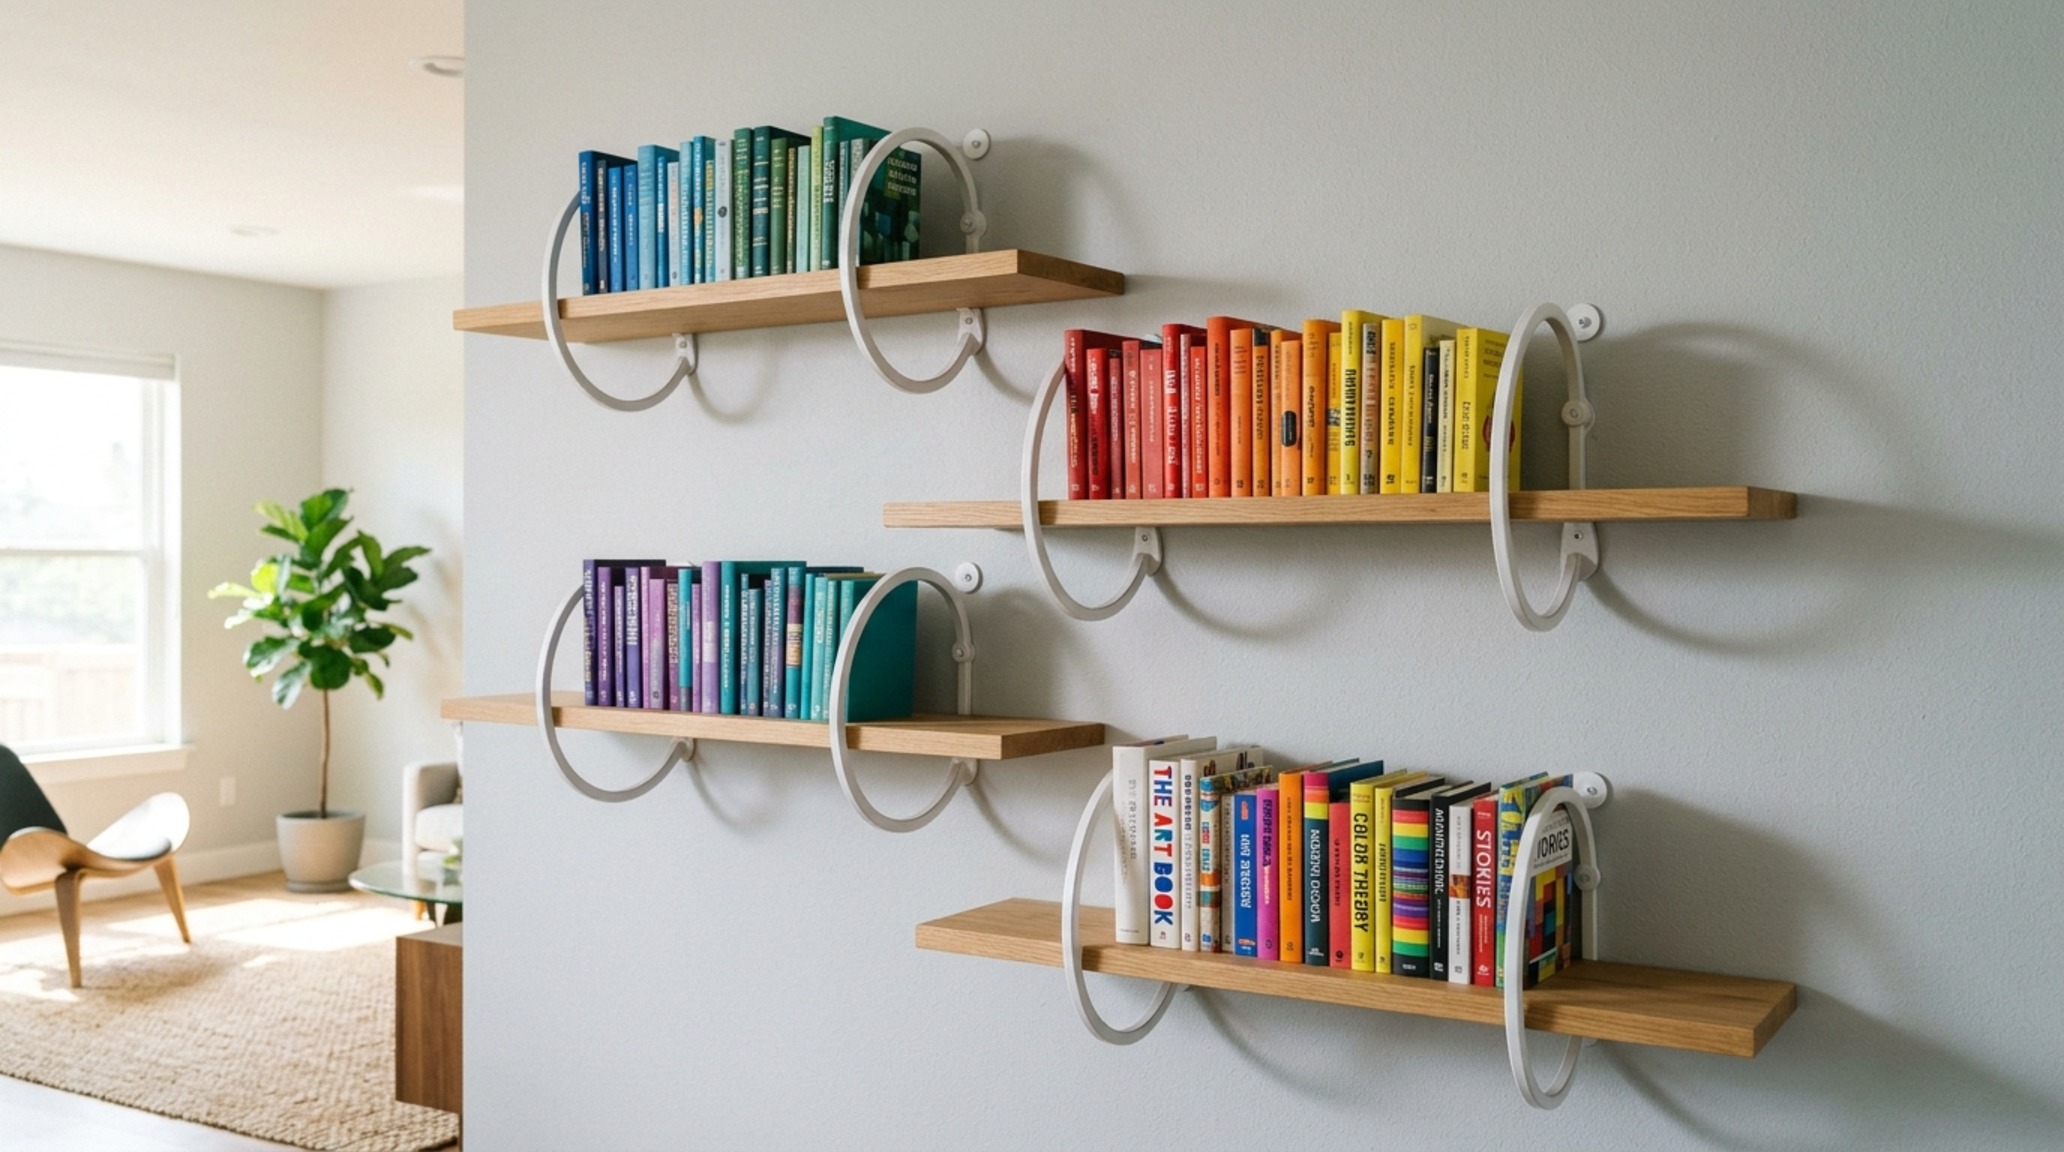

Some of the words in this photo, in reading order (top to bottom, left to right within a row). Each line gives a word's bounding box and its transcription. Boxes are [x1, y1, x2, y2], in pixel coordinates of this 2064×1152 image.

[1153, 766, 1173, 807] THE
[1153, 812, 1174, 858] ART
[1536, 829, 1570, 859] ORIES
[1153, 862, 1174, 926] BOOK
